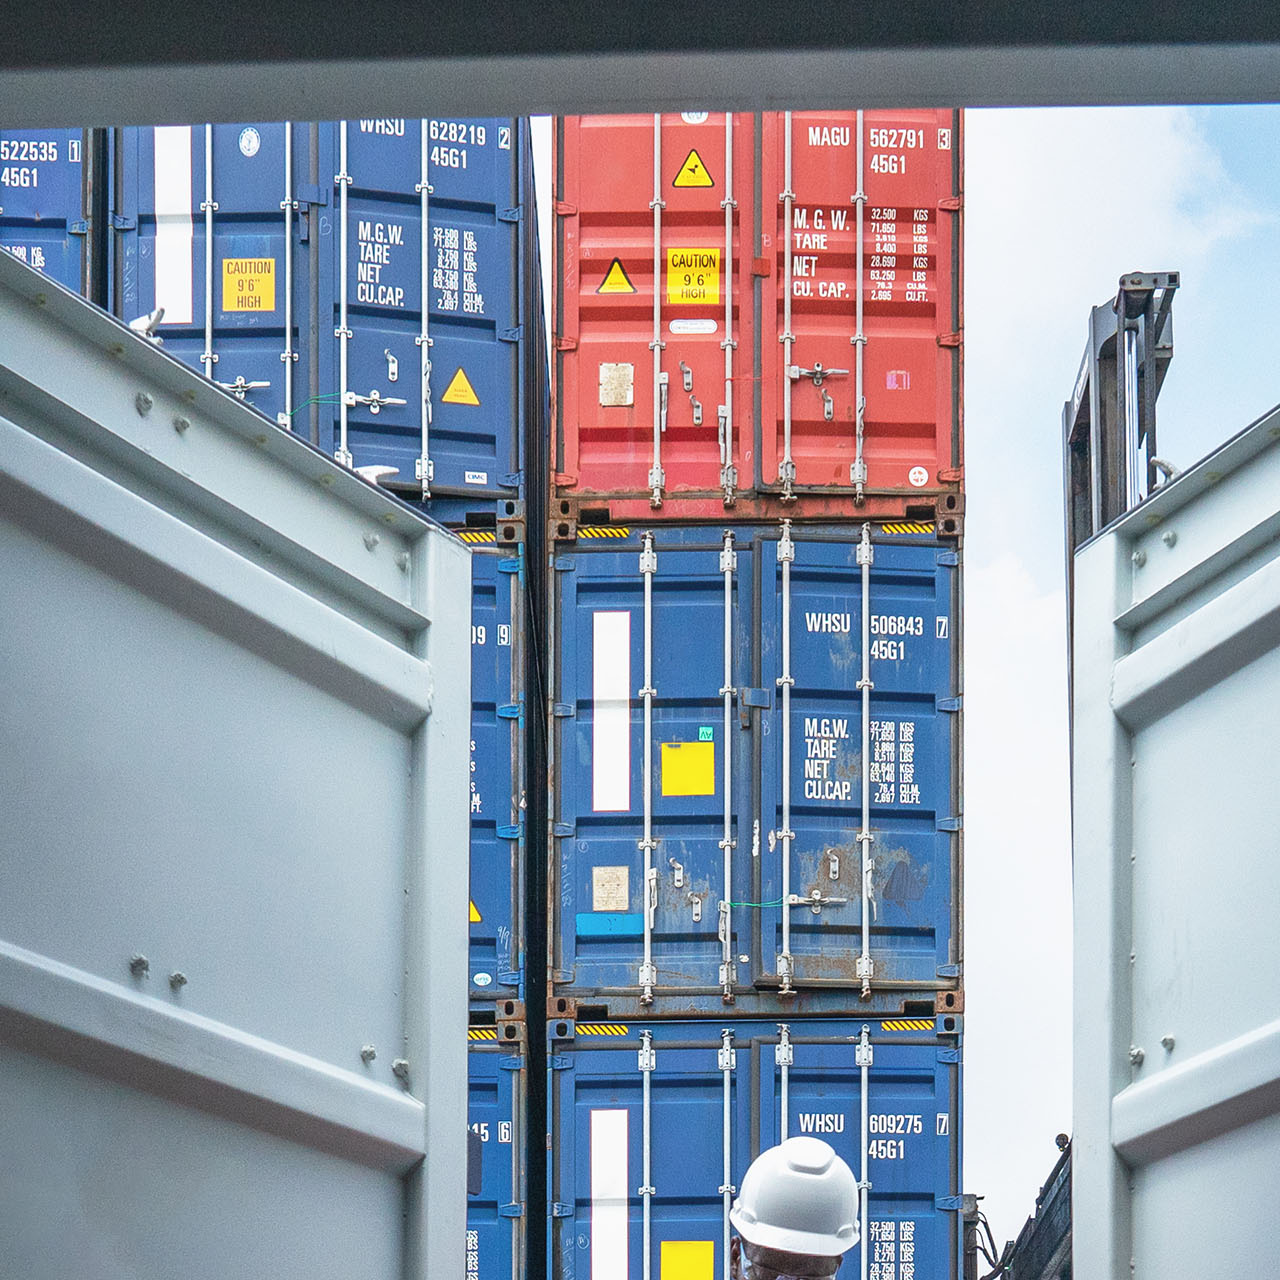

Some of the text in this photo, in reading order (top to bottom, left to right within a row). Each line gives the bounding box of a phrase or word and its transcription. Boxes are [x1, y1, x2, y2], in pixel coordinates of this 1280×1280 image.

[429, 120, 486, 145] 628219
[808, 127, 850, 146] MAGU
[870, 129, 924, 148] 562791
[0, 141, 58, 162] 522535
[431, 146, 467, 168] 45G1
[870, 154, 906, 174] 45G1
[1, 168, 38, 188] 45G1
[913, 209, 928, 221] KGS
[359, 221, 404, 246] M.G.W.
[912, 224, 927, 234] LBS
[794, 234, 828, 250] TARE
[913, 244, 928, 254] LBS
[359, 242, 390, 264] TARE
[671, 254, 716, 268] CAUTION
[226, 261, 271, 275] CAUTION
[358, 262, 382, 284] NET
[793, 256, 818, 276] NET
[912, 256, 928, 268] KGS
[912, 271, 926, 282] LBS
[236, 296, 261, 309] HIGH
[357, 283, 404, 307] CU.CAP.
[681, 288, 706, 300] HIGH
[806, 612, 851, 633] WHSU
[870, 615, 924, 636] 506843
[870, 640, 905, 660] 45G1
[805, 718, 850, 739] M.G.W.
[805, 738, 837, 759] TARE
[805, 760, 830, 779] NET
[805, 780, 852, 800] CU.CAP.
[799, 1113, 844, 1133] WHSU
[870, 1114, 923, 1134] 609275
[868, 1140, 905, 1160] 45G1
